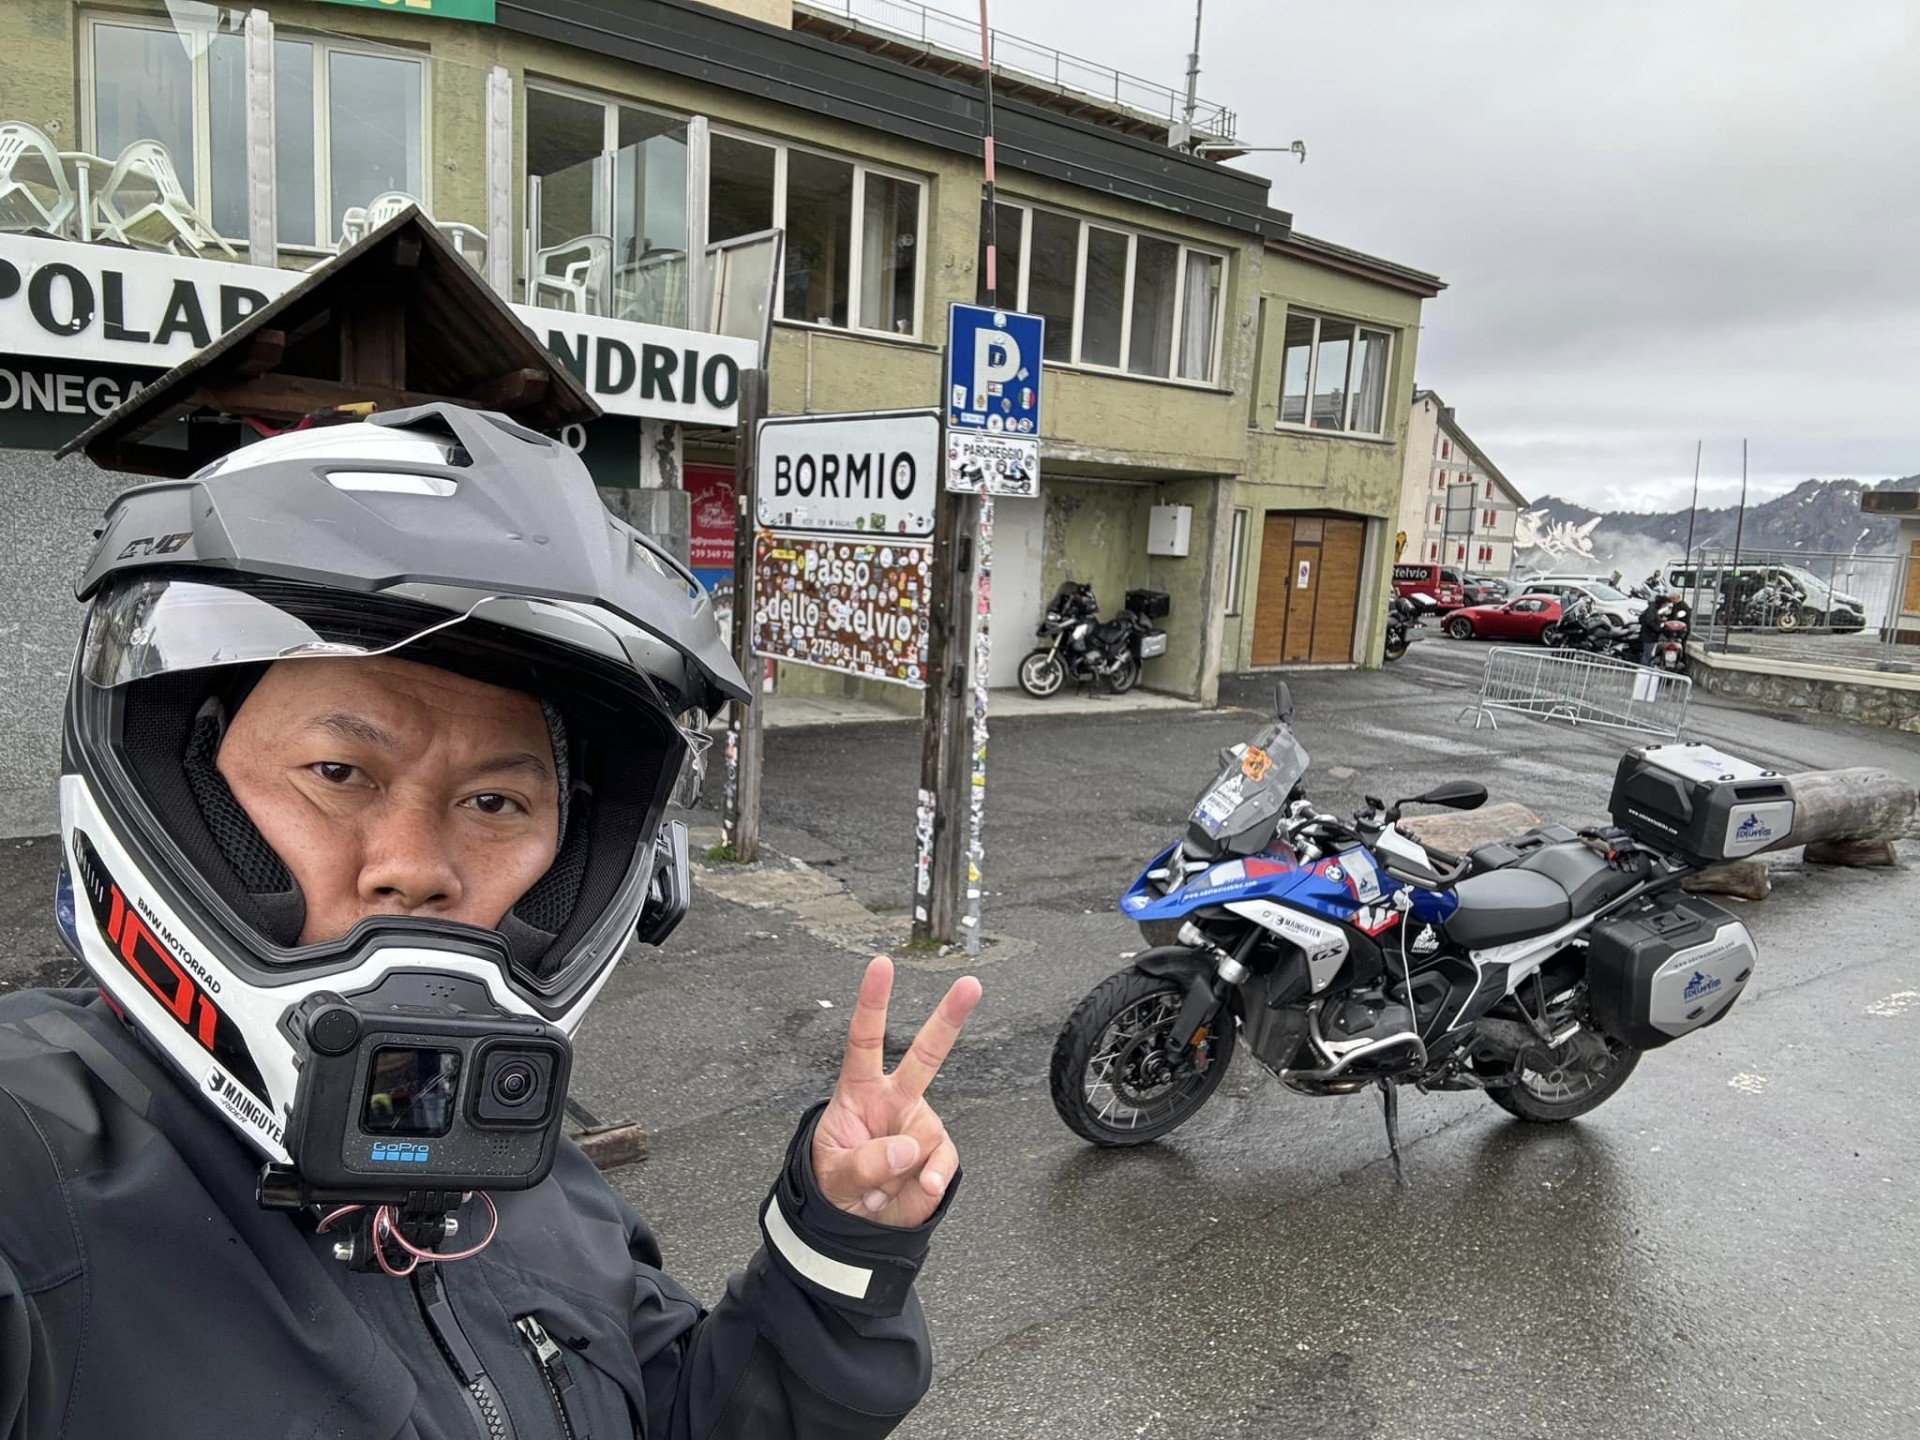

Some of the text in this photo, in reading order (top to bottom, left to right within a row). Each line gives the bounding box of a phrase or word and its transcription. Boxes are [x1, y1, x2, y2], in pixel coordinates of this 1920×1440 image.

[972, 327, 1021, 411] P
[963, 443, 1024, 461] PARCHEGGIO
[775, 451, 916, 500] BORMIO
[804, 549, 869, 587] Passo
[768, 590, 912, 642] dello Stelvio
[811, 638, 840, 658] 2758
[137, 897, 222, 994] BMW MOTORRAD
[1312, 944, 1343, 962] GS
[373, 1141, 430, 1153] GoPro
